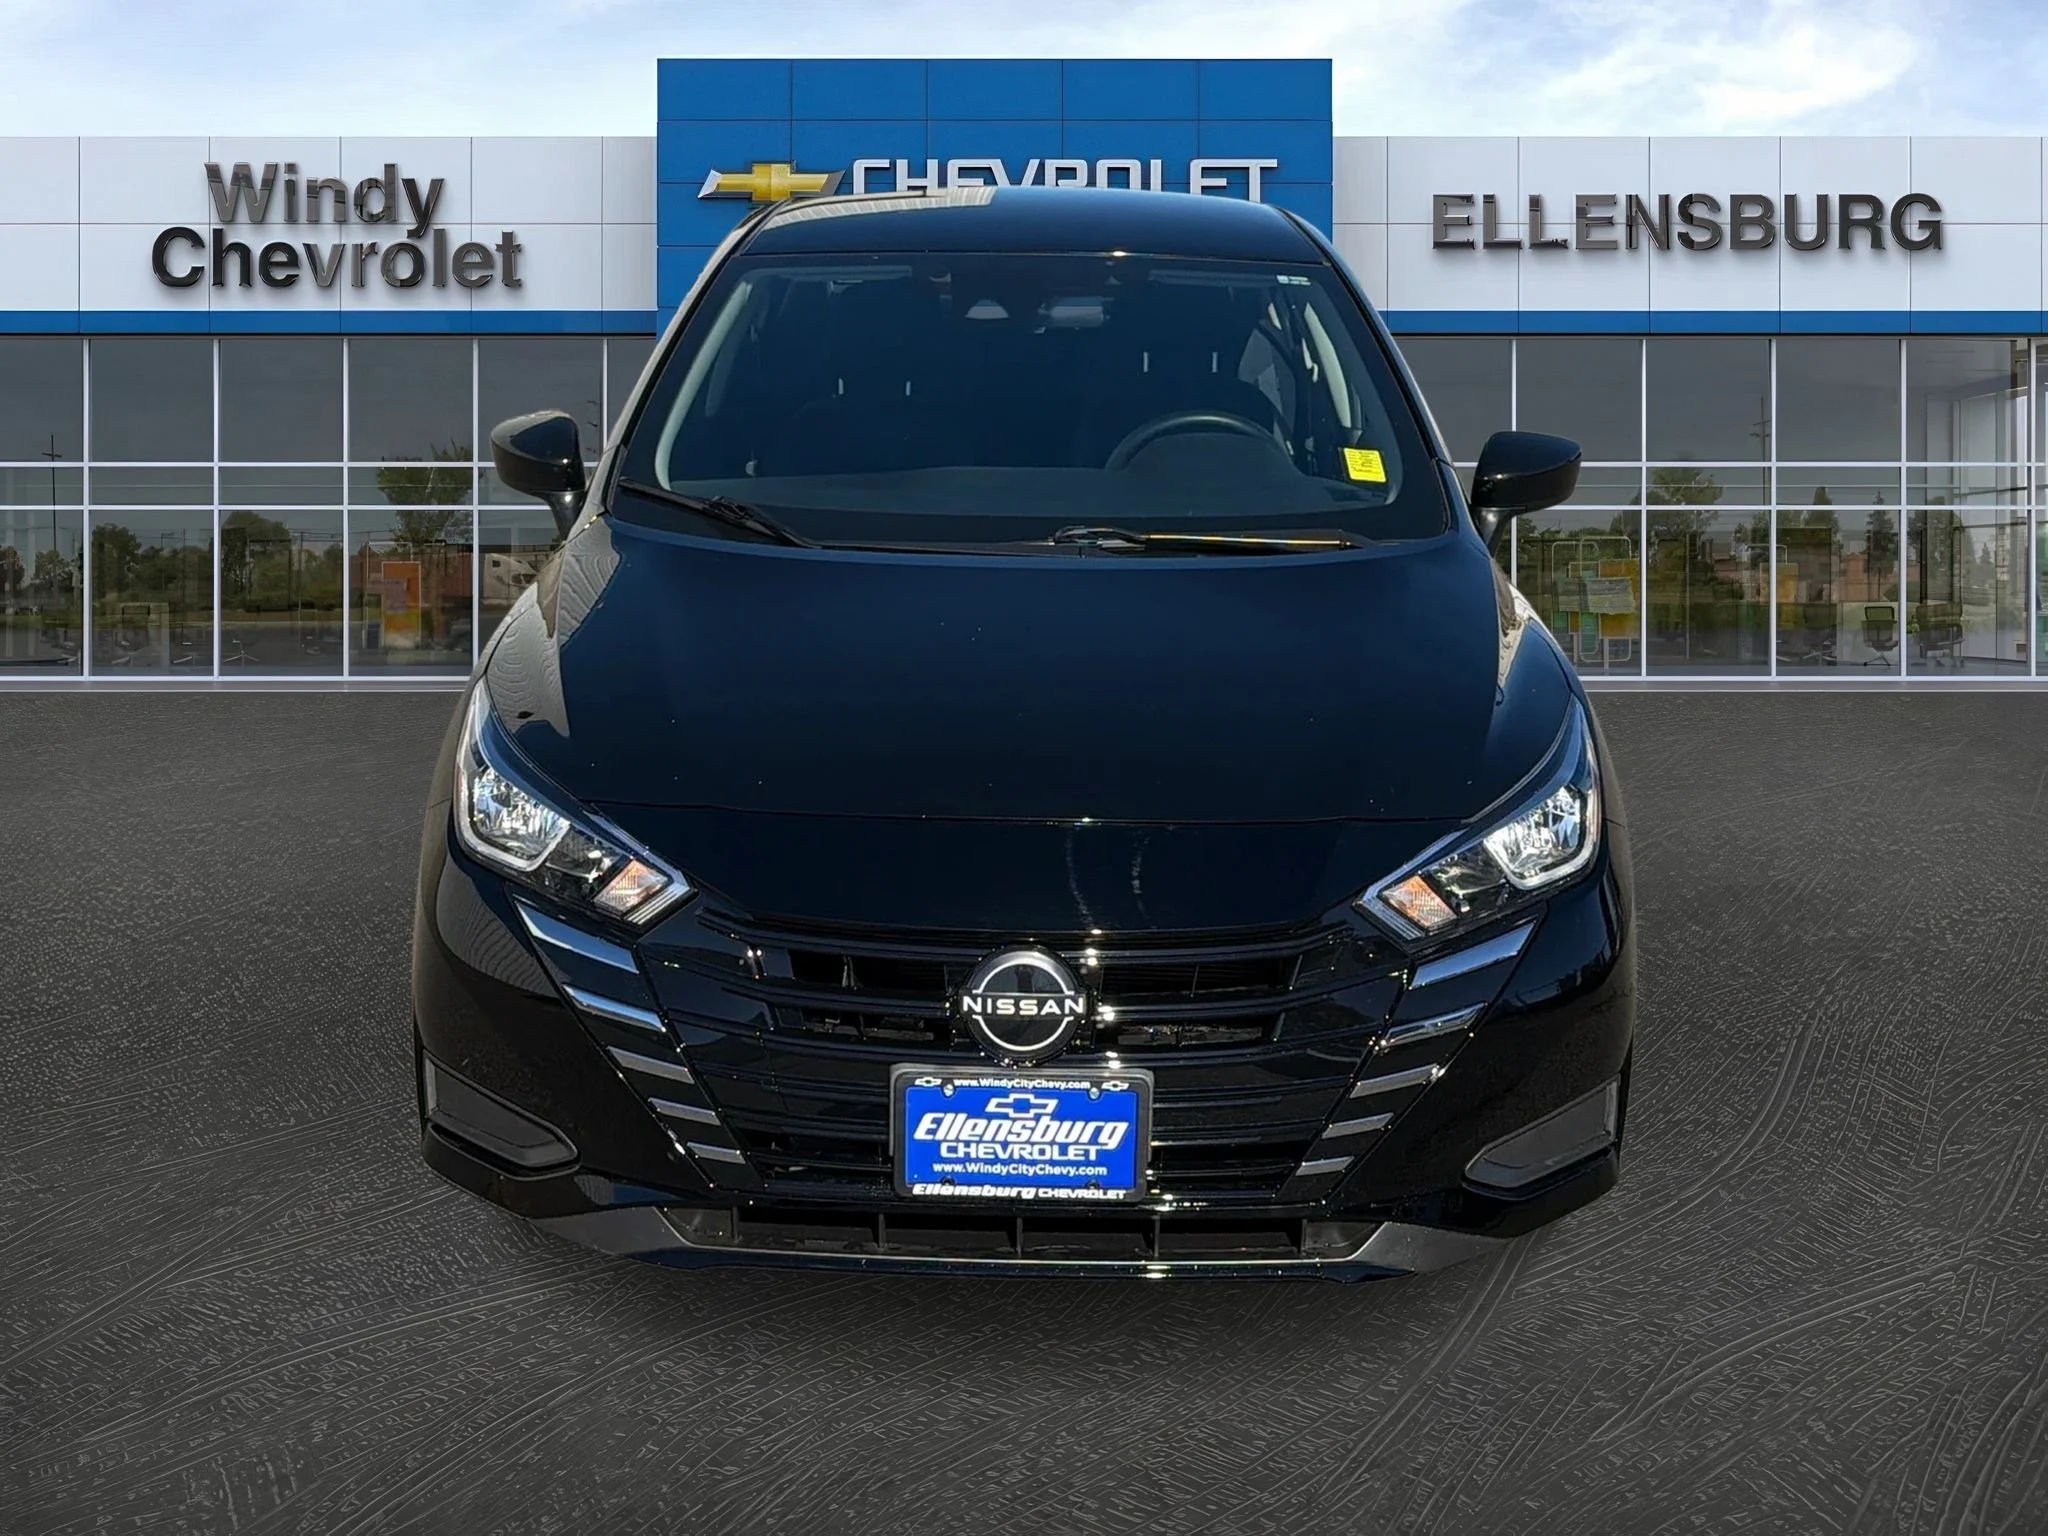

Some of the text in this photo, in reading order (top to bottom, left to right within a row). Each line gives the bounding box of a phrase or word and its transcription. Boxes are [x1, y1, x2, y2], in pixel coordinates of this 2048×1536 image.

[853, 158, 1279, 204] CHEVROLET
[204, 161, 445, 238] Windy
[1431, 193, 1944, 251] ELLENSBURG
[151, 226, 524, 290] Chevrolet
[962, 995, 1085, 1016] NISSAN
[952, 1077, 1091, 1091] www.WindyCityChevy.com
[913, 1112, 1129, 1151] Ellensburg
[939, 1141, 1099, 1161] CHEVROLET
[932, 1162, 1108, 1177] www.WindyCityChevy.com
[911, 1183, 1127, 1200] Ellensburg CHEVROLET
